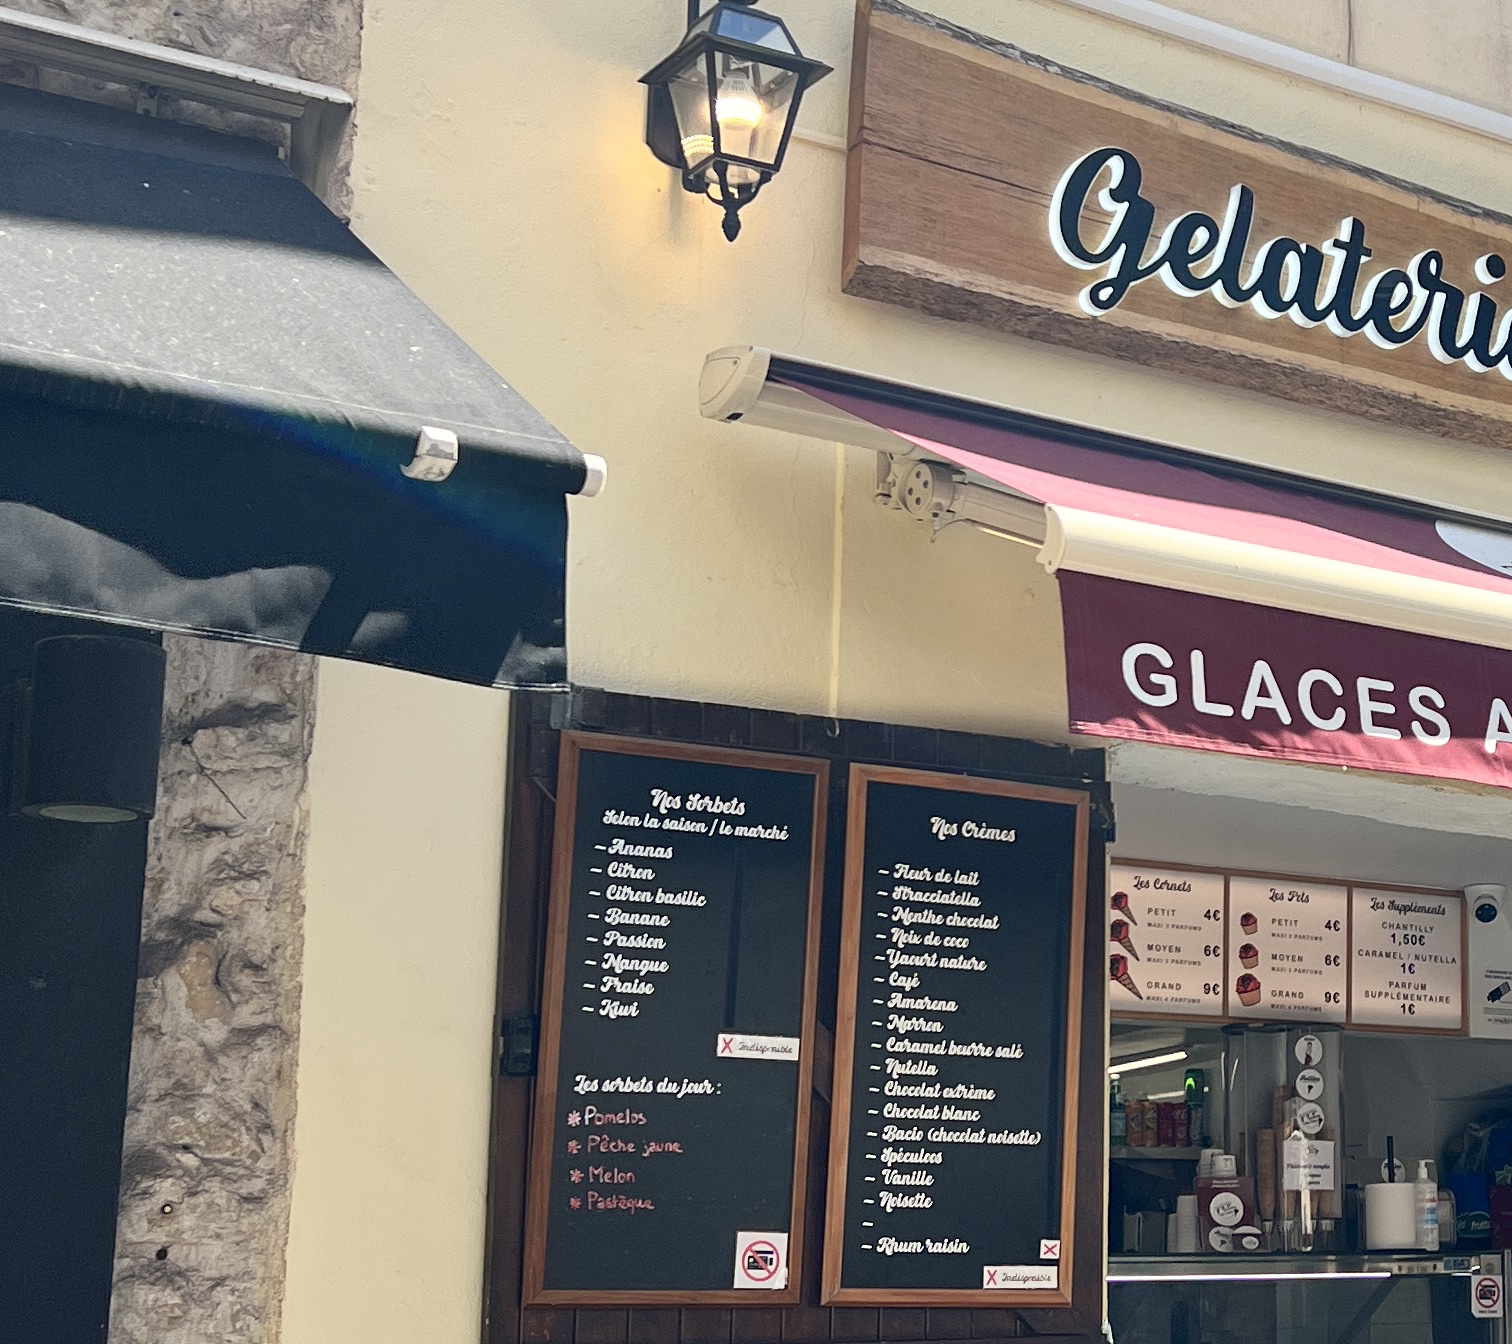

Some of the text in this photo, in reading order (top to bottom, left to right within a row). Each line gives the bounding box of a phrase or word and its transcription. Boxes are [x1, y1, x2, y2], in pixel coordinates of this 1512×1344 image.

[1120, 640, 1451, 748] GLACES
[650, 788, 746, 816] Nos Sorbets
[603, 809, 642, 827] Selon
[643, 813, 662, 829] la
[662, 817, 708, 833] saison
[719, 821, 733, 835] le
[734, 825, 789, 840] marché
[930, 816, 1016, 842] Nos Crèmes
[607, 838, 674, 859] Ananas
[607, 861, 656, 880] Citron
[893, 863, 981, 886] Fleur de lait
[1133, 875, 1192, 893] Les Cornets
[605, 884, 707, 907] Citron basilic
[892, 885, 982, 907] Stracciatella
[1269, 888, 1310, 903] Les Pots
[1147, 907, 1221, 921] PETIT 4€
[1370, 897, 1446, 916] Les Suppléments
[604, 907, 670, 927] Banane
[891, 906, 1000, 930] Menthe chocolat
[1271, 918, 1341, 931] PETIT 4€
[1381, 921, 1434, 933] CHANTILLY
[602, 930, 666, 951] Passion
[890, 927, 970, 949] Noix de coco
[1391, 933, 1426, 946] 1,50€
[886, 948, 987, 971] Yaourt nature
[1147, 943, 1221, 957] MOYEN 6€
[1271, 953, 1340, 967] MOYEN 6€
[1358, 949, 1457, 964] CARAMEL NUTELLA
[600, 952, 670, 977] Mangue
[1401, 962, 1416, 974] 1€
[600, 976, 655, 995] Fraise
[888, 971, 921, 992] Café
[1146, 981, 1220, 995] GRAND 9€
[1388, 981, 1427, 990] PARFUM
[887, 992, 958, 1012] Amarena
[1271, 990, 1340, 1004] GRAND 9€
[1364, 990, 1450, 1004] SUPPLÉMENTAIRE
[599, 999, 640, 1019] Kiwi
[1401, 1003, 1416, 1015] 1€
[887, 1014, 944, 1033] Marron
[885, 1036, 1024, 1059] Caramel beurre salé
[885, 1057, 939, 1079] Nutella
[573, 1074, 715, 1099] Les sorbets du jour
[883, 1080, 943, 1098] Chocolat
[584, 1105, 648, 1126] Pomelos
[883, 1102, 981, 1121] Chocolat blanc
[881, 1125, 1042, 1145] Bacio (chocolat noisette)
[587, 1135, 683, 1156] Pêche jaune
[880, 1147, 943, 1167] Spéculoos
[588, 1166, 636, 1184] Melon
[881, 1169, 934, 1187] Vanille
[879, 1191, 933, 1213] Noisette
[876, 1237, 970, 1256] Rhum raisin
